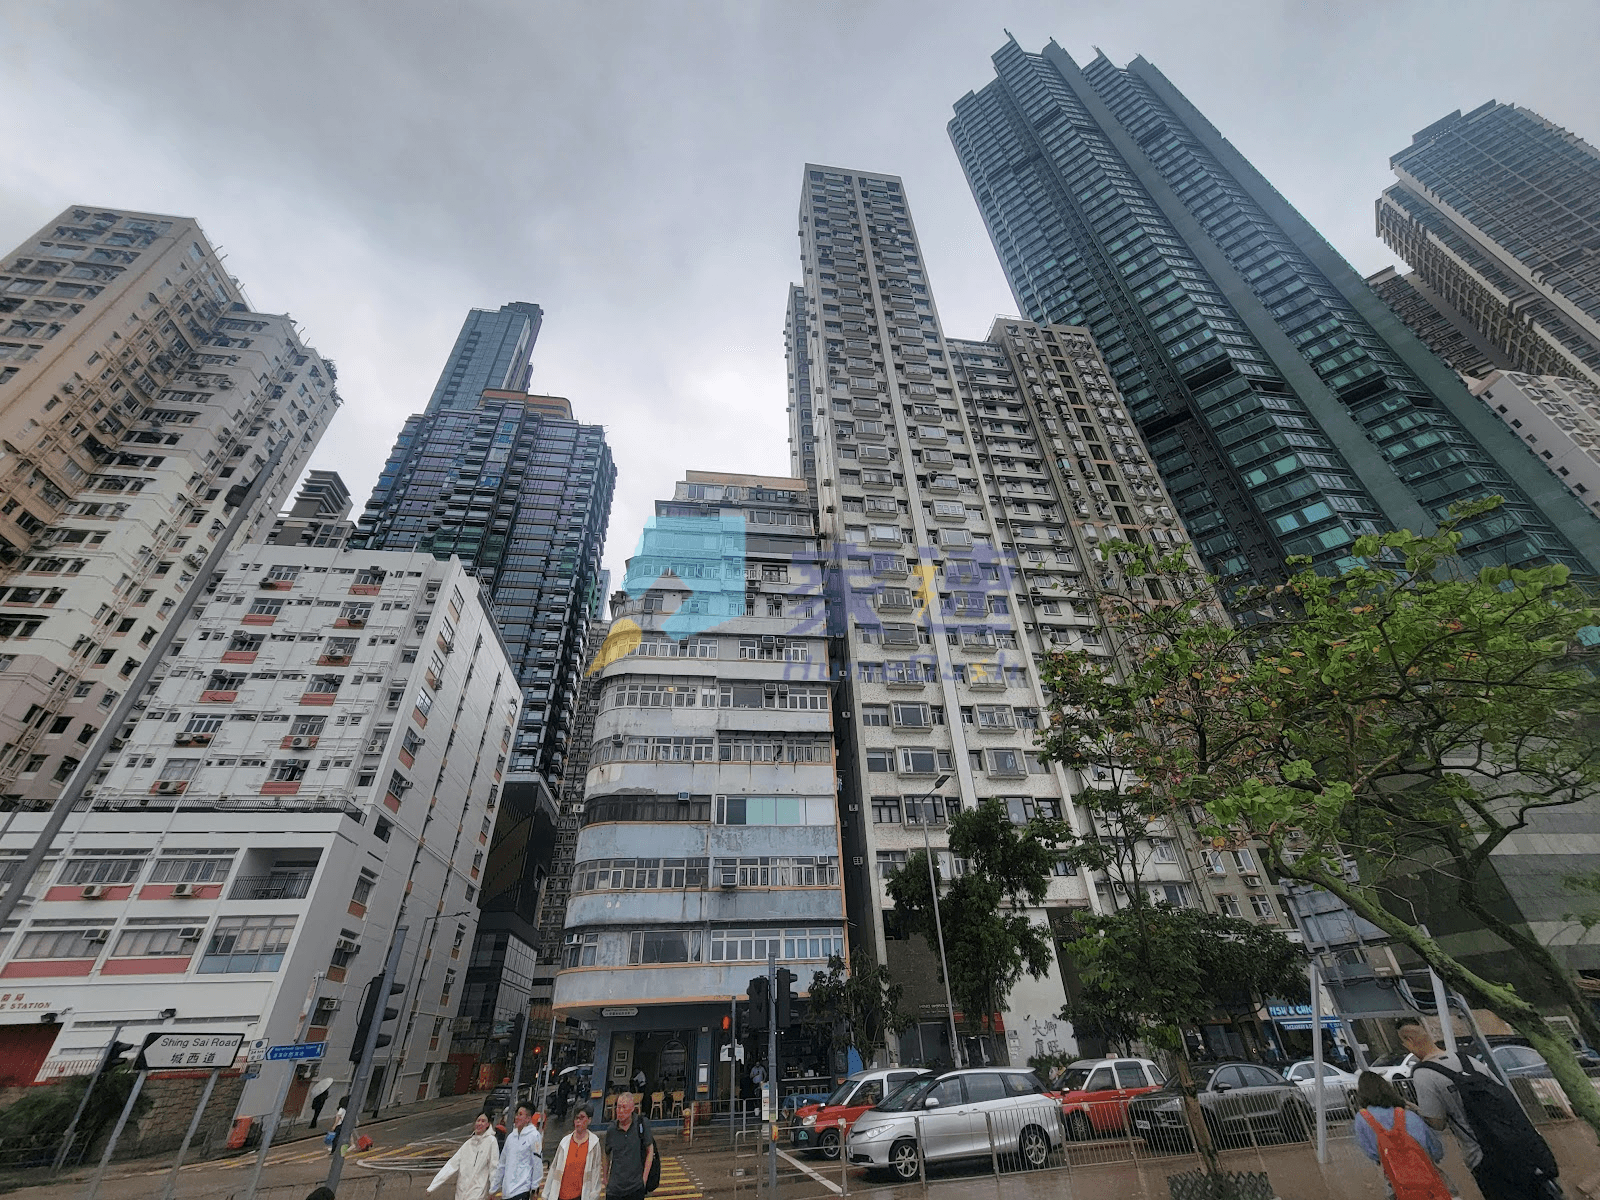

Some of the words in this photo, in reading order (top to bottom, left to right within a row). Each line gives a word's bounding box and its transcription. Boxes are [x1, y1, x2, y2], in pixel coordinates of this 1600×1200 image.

[10, 1002, 52, 1010] STATION
[1268, 1006, 1287, 1015] FISH
[161, 1037, 189, 1048] Shing
[192, 1037, 209, 1047] Sai
[210, 1037, 239, 1047] Road
[170, 1051, 216, 1064] 城西道
